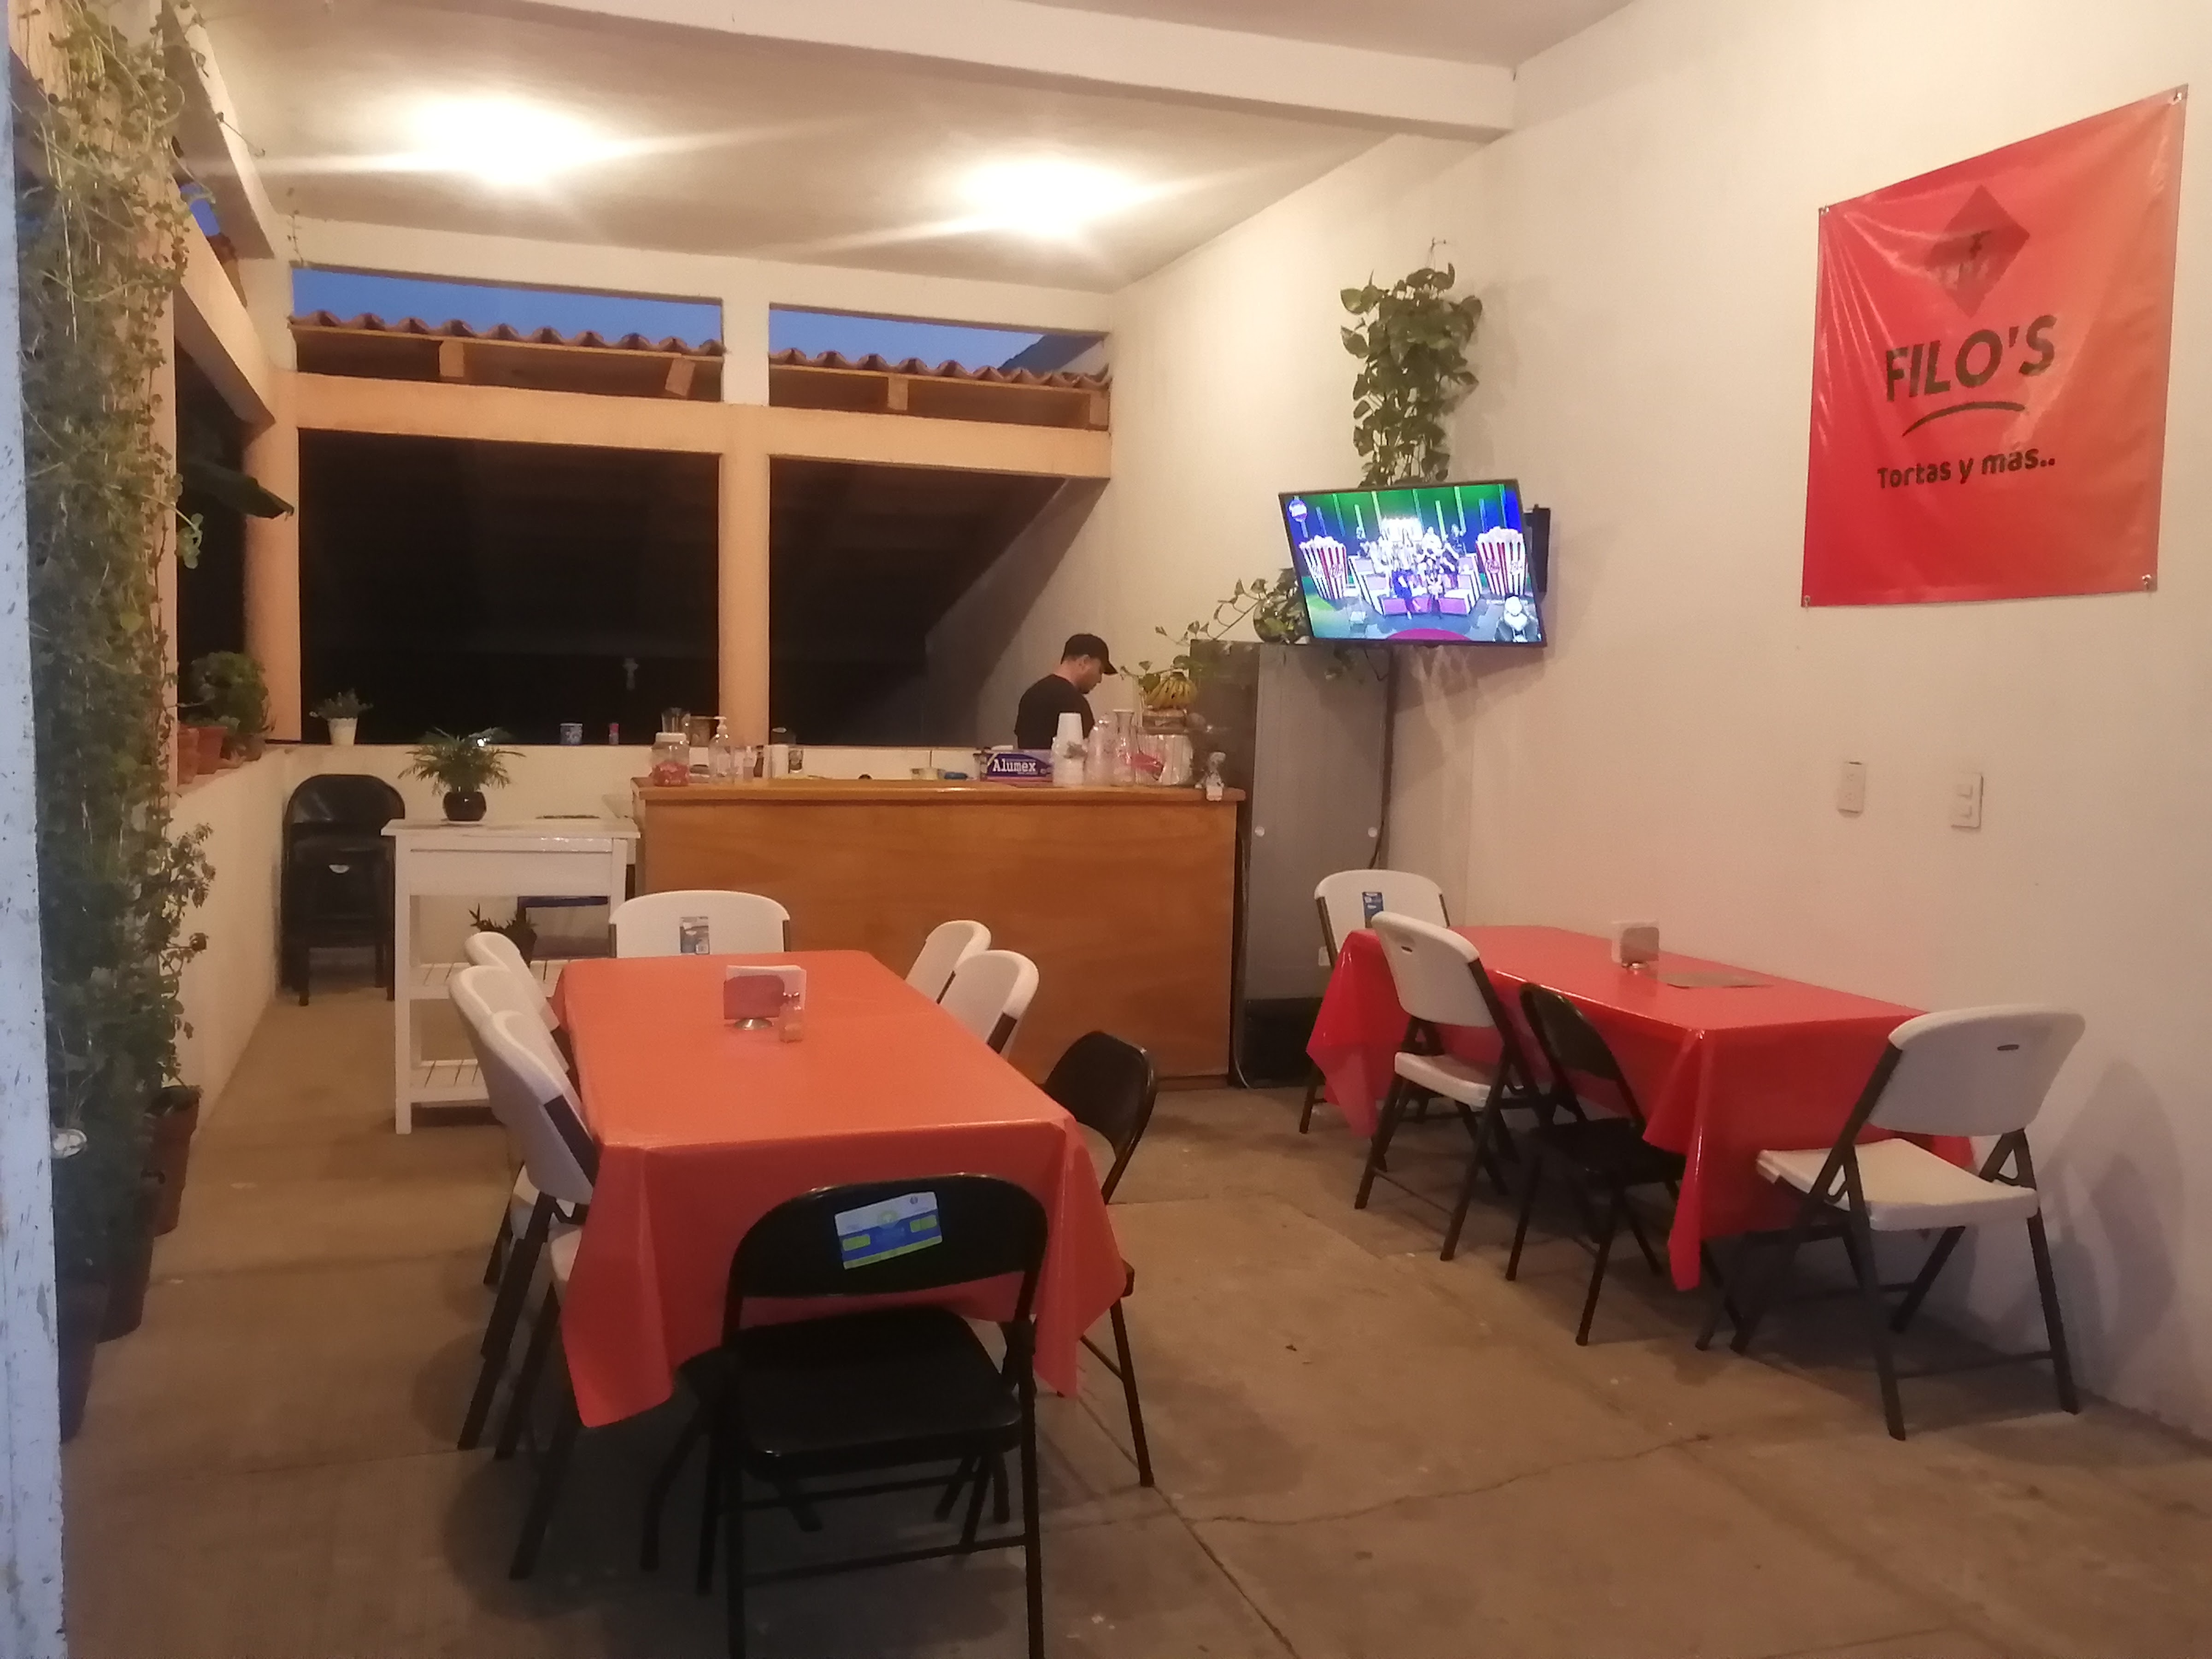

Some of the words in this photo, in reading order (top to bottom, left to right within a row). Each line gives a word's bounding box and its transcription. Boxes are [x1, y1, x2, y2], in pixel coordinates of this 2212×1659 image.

[1886, 314, 2057, 402] FILO'S
[1877, 461, 1951, 488] Tortas
[1959, 458, 1974, 484] y
[992, 758, 1036, 772] Alumex
